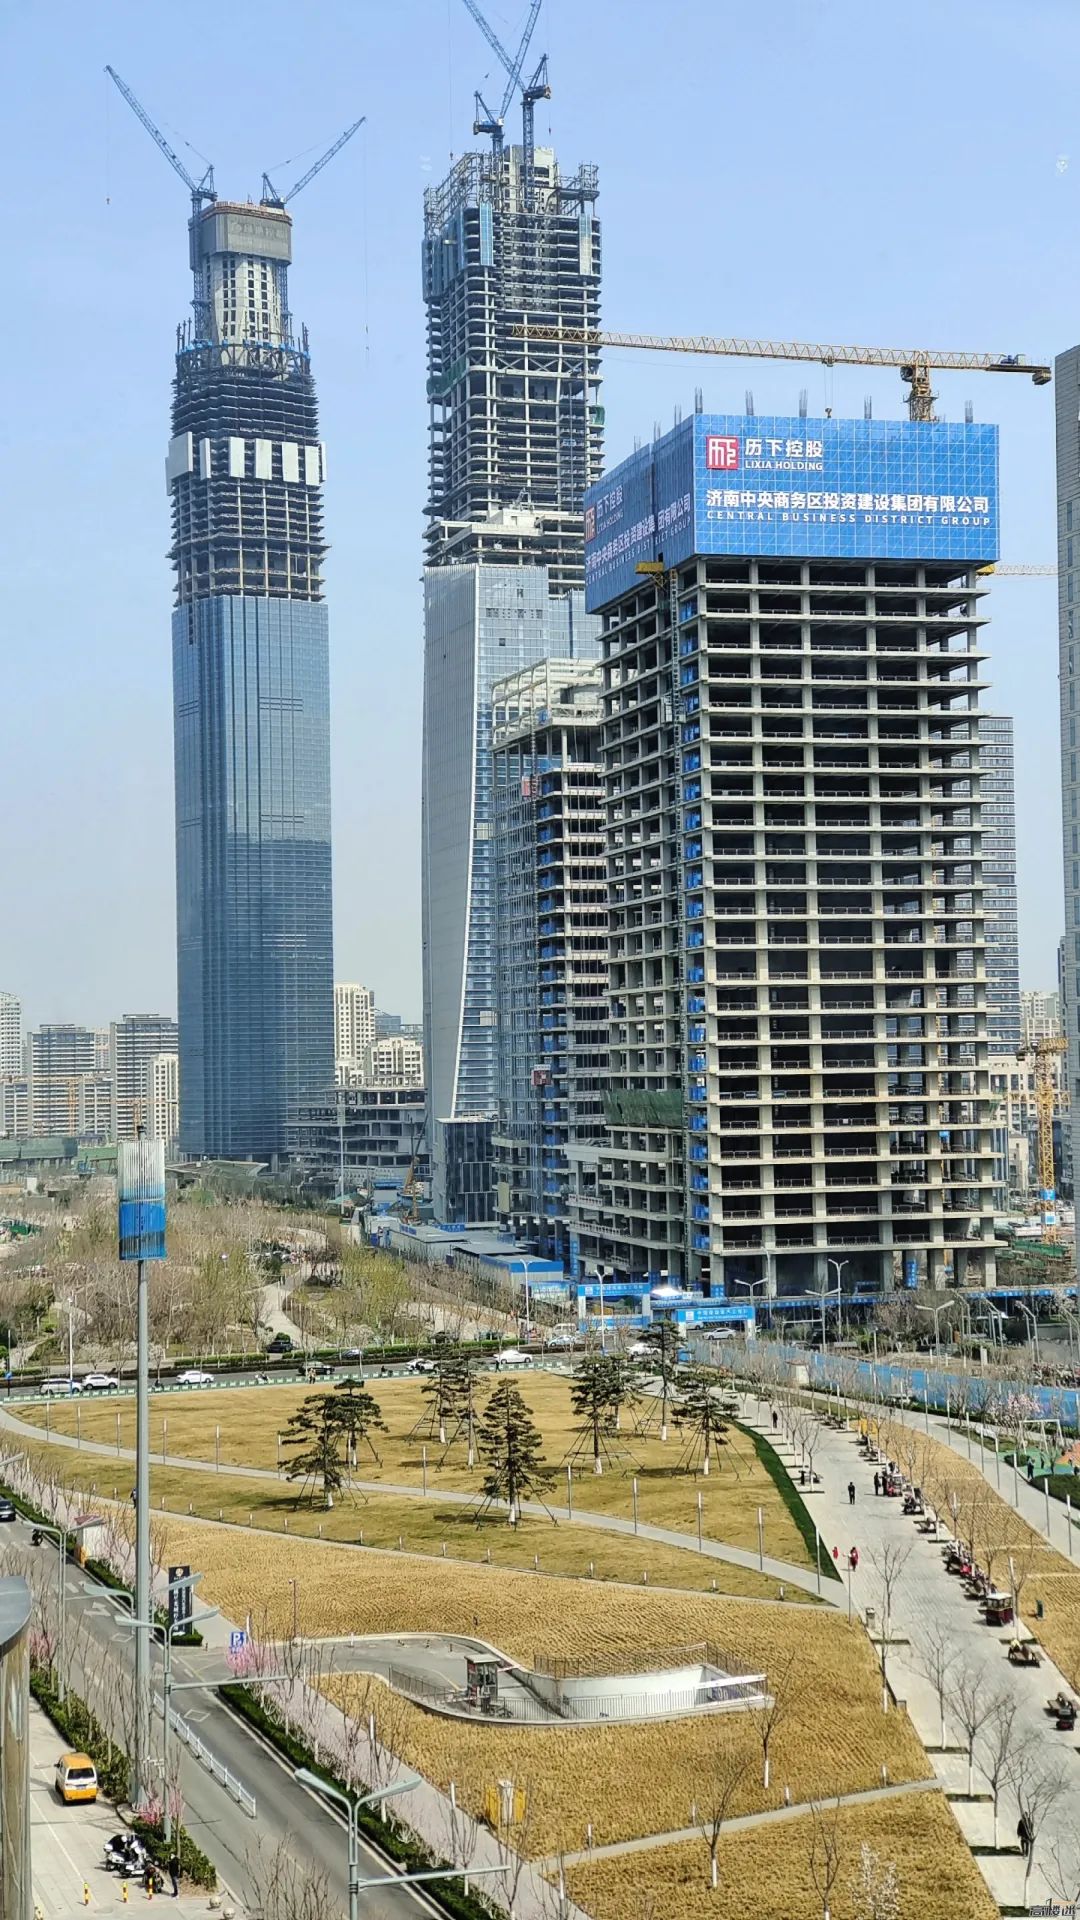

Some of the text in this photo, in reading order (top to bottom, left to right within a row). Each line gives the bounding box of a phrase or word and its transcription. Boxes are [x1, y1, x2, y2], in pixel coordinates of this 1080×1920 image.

[744, 437, 823, 458] 历下控股
[744, 460, 823, 471] LIXIA HOLDING
[706, 489, 989, 514] 济南中央商务区投资建设集团有限公司
[706, 511, 990, 526] CENTRAL BUSINESS DISTRICT GROUP
[233, 1632, 241, 1647] P
